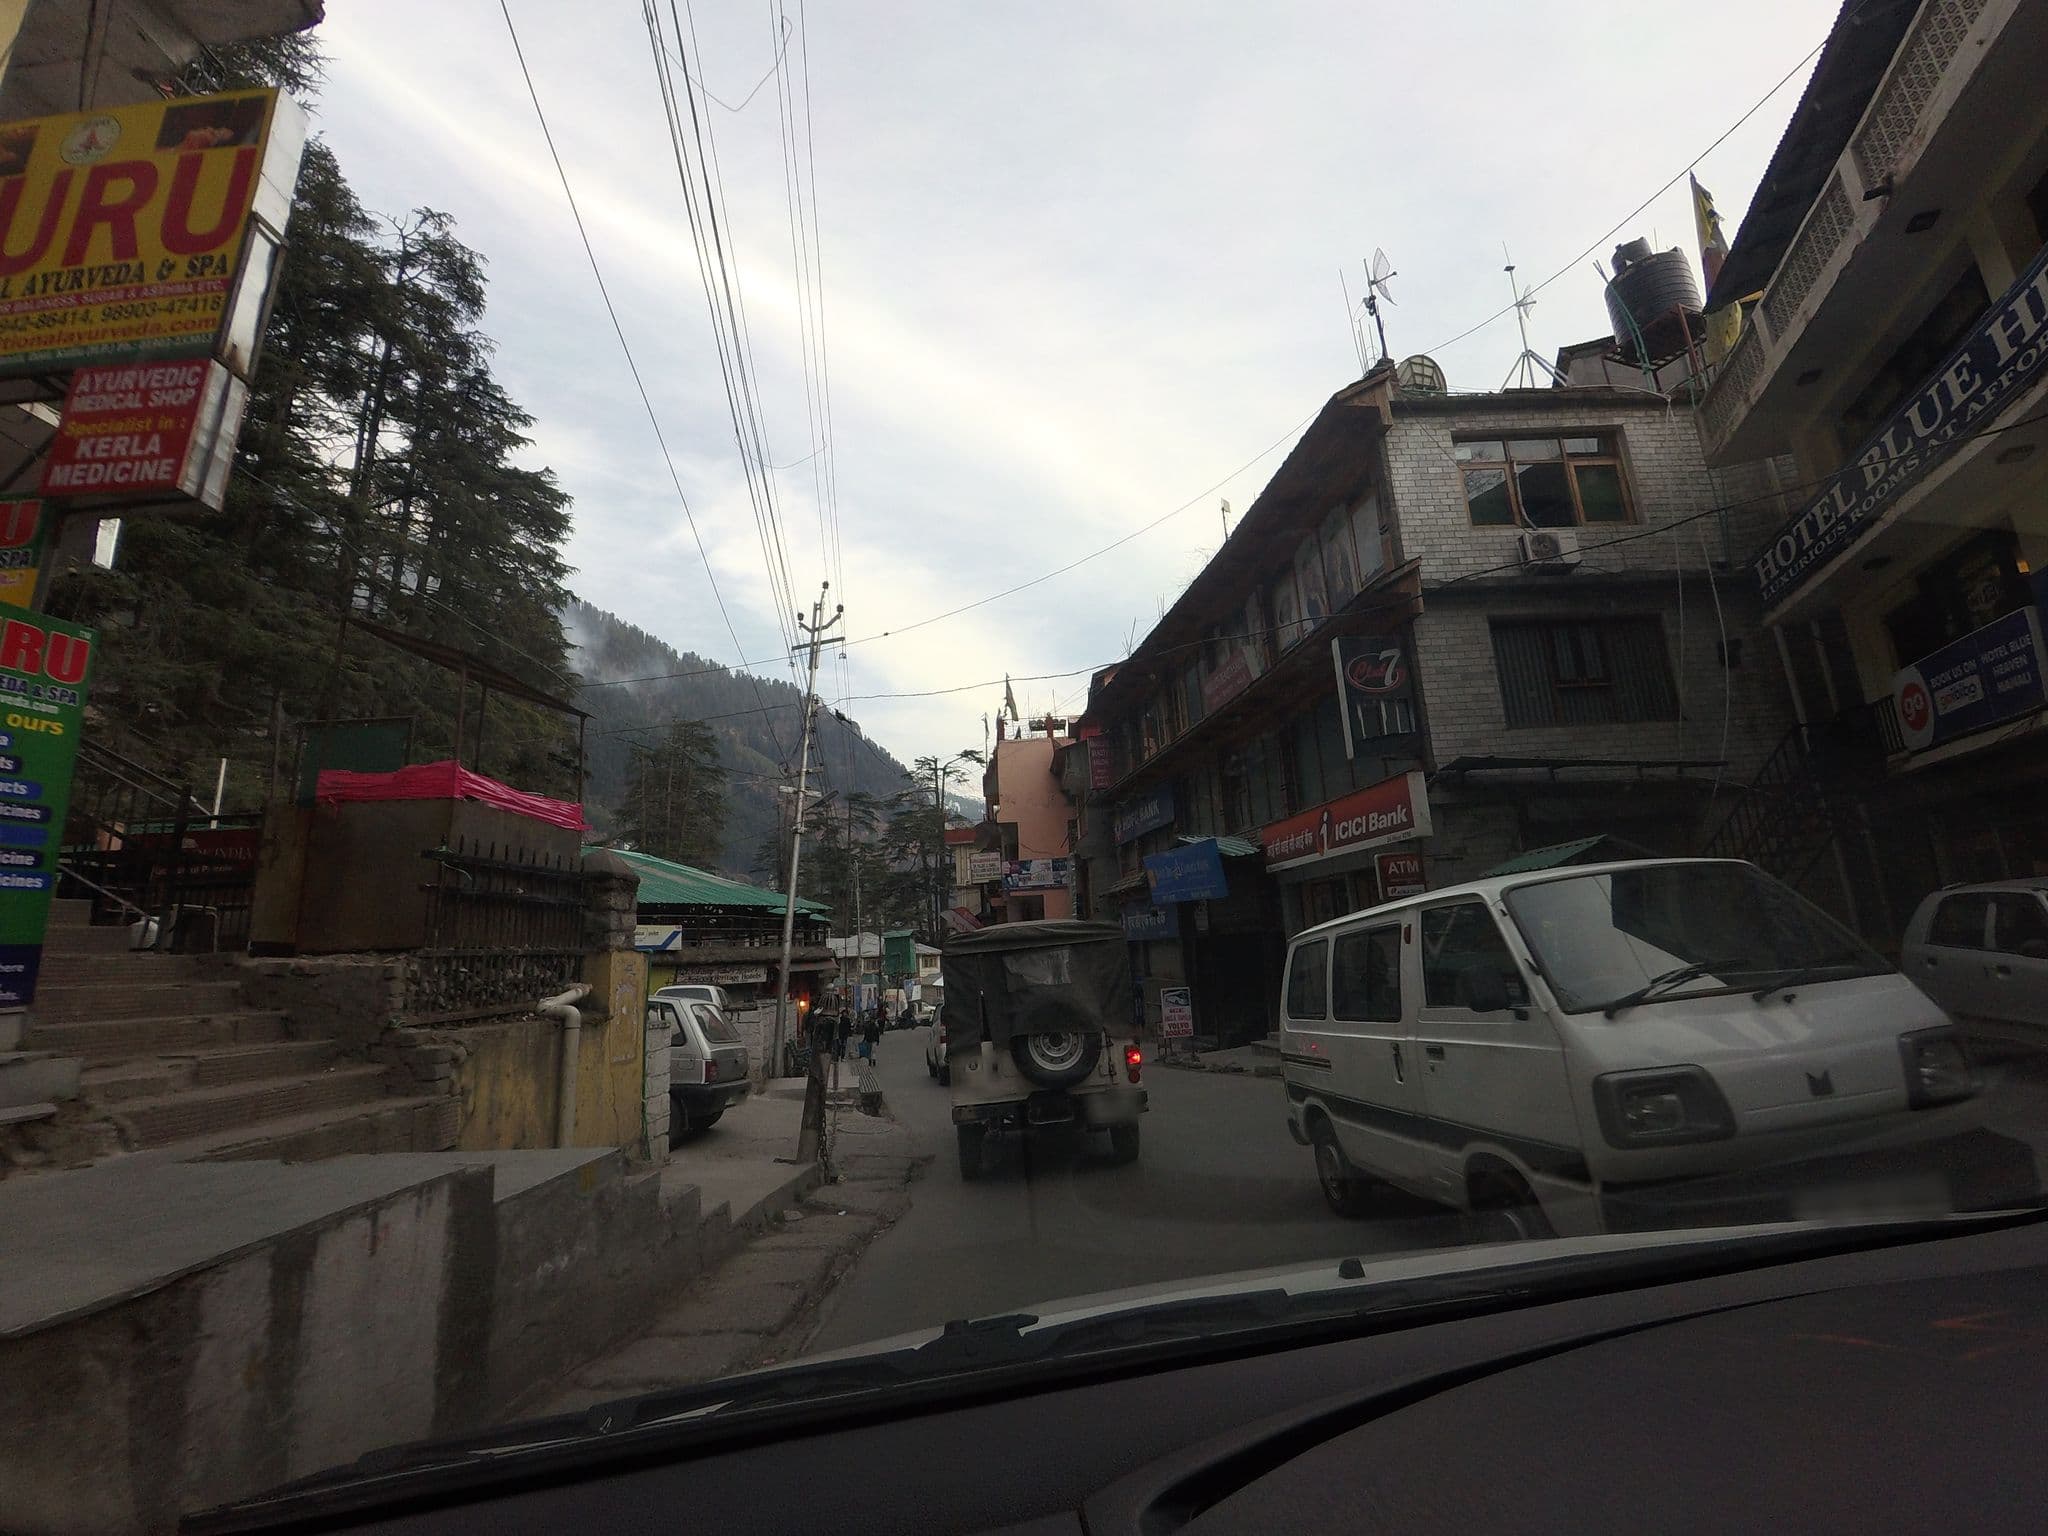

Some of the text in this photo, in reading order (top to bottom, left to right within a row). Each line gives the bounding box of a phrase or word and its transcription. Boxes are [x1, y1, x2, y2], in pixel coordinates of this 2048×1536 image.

[22, 262, 145, 297] AYURVEDA
[157, 258, 176, 280] &
[185, 254, 228, 278] SPA
[75, 366, 203, 394] AYURVEDIC
[69, 387, 196, 413] MEDICAL SHOP
[74, 433, 162, 460] KERLA
[47, 458, 177, 488] MEDICINE
[1754, 481, 1859, 587] HOTEL
[1858, 355, 1983, 491] BLUE
[1762, 522, 1849, 600] LUXURIOUS
[1849, 454, 1921, 532] ROOMS
[1925, 418, 1958, 458] AT
[1981, 634, 2032, 665] HOTEL BLUE
[1930, 669, 1952, 689] BOOK
[1963, 658, 1978, 673] ON
[1993, 654, 2028, 676] HEAVEN
[31, 683, 43, 699] &
[47, 685, 79, 707] SPA
[1335, 815, 1366, 842] ICICI
[1368, 804, 1409, 832] Bank
[1388, 860, 1420, 876] ATM
[1167, 1022, 1190, 1030] VOLVO
